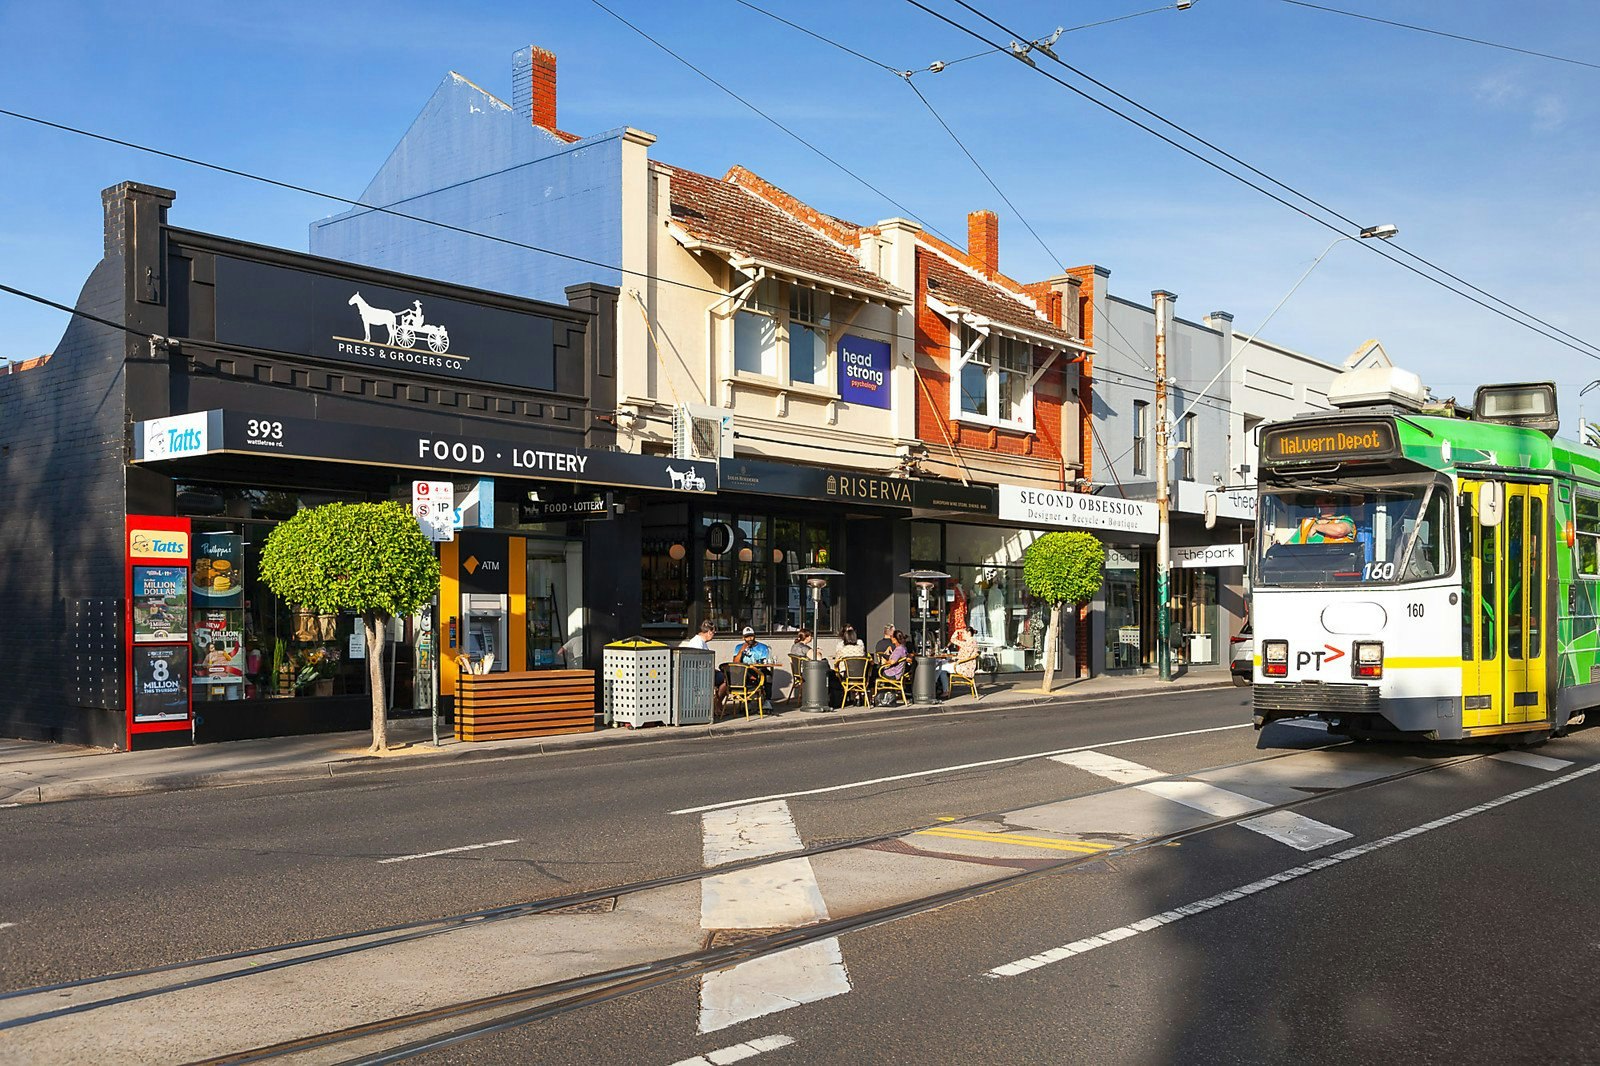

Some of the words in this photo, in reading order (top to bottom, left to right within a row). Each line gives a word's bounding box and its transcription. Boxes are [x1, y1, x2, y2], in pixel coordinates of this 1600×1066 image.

[338, 343, 375, 357] PRESS
[379, 349, 387, 359] &
[389, 351, 442, 367] GROCERS
[446, 360, 463, 370] CO.
[843, 348, 872, 367] head
[847, 365, 883, 386] strong
[851, 379, 877, 391] psychology
[247, 419, 283, 439] 393
[168, 428, 202, 453] Tatts
[247, 439, 275, 447] wattletree
[1280, 434, 1335, 455] Malvern
[1338, 430, 1381, 451] Depot
[418, 438, 485, 464] FOOD
[512, 449, 588, 473] LOTTERY
[840, 476, 912, 502] RISERVA
[544, 503, 568, 513] FOOD
[573, 500, 604, 511] LOTTERY
[1020, 490, 1074, 509] SECOND
[1079, 498, 1144, 516] OBSESSION
[1229, 492, 1257, 515] thep
[1027, 509, 1061, 524] Designer
[1072, 511, 1099, 526] Recycle
[1108, 517, 1138, 530] Boutique
[152, 540, 184, 553] Tatts
[481, 561, 500, 570] ATM
[1364, 562, 1395, 581] 160
[1406, 603, 1424, 618] 160
[143, 681, 179, 689] MILLION
